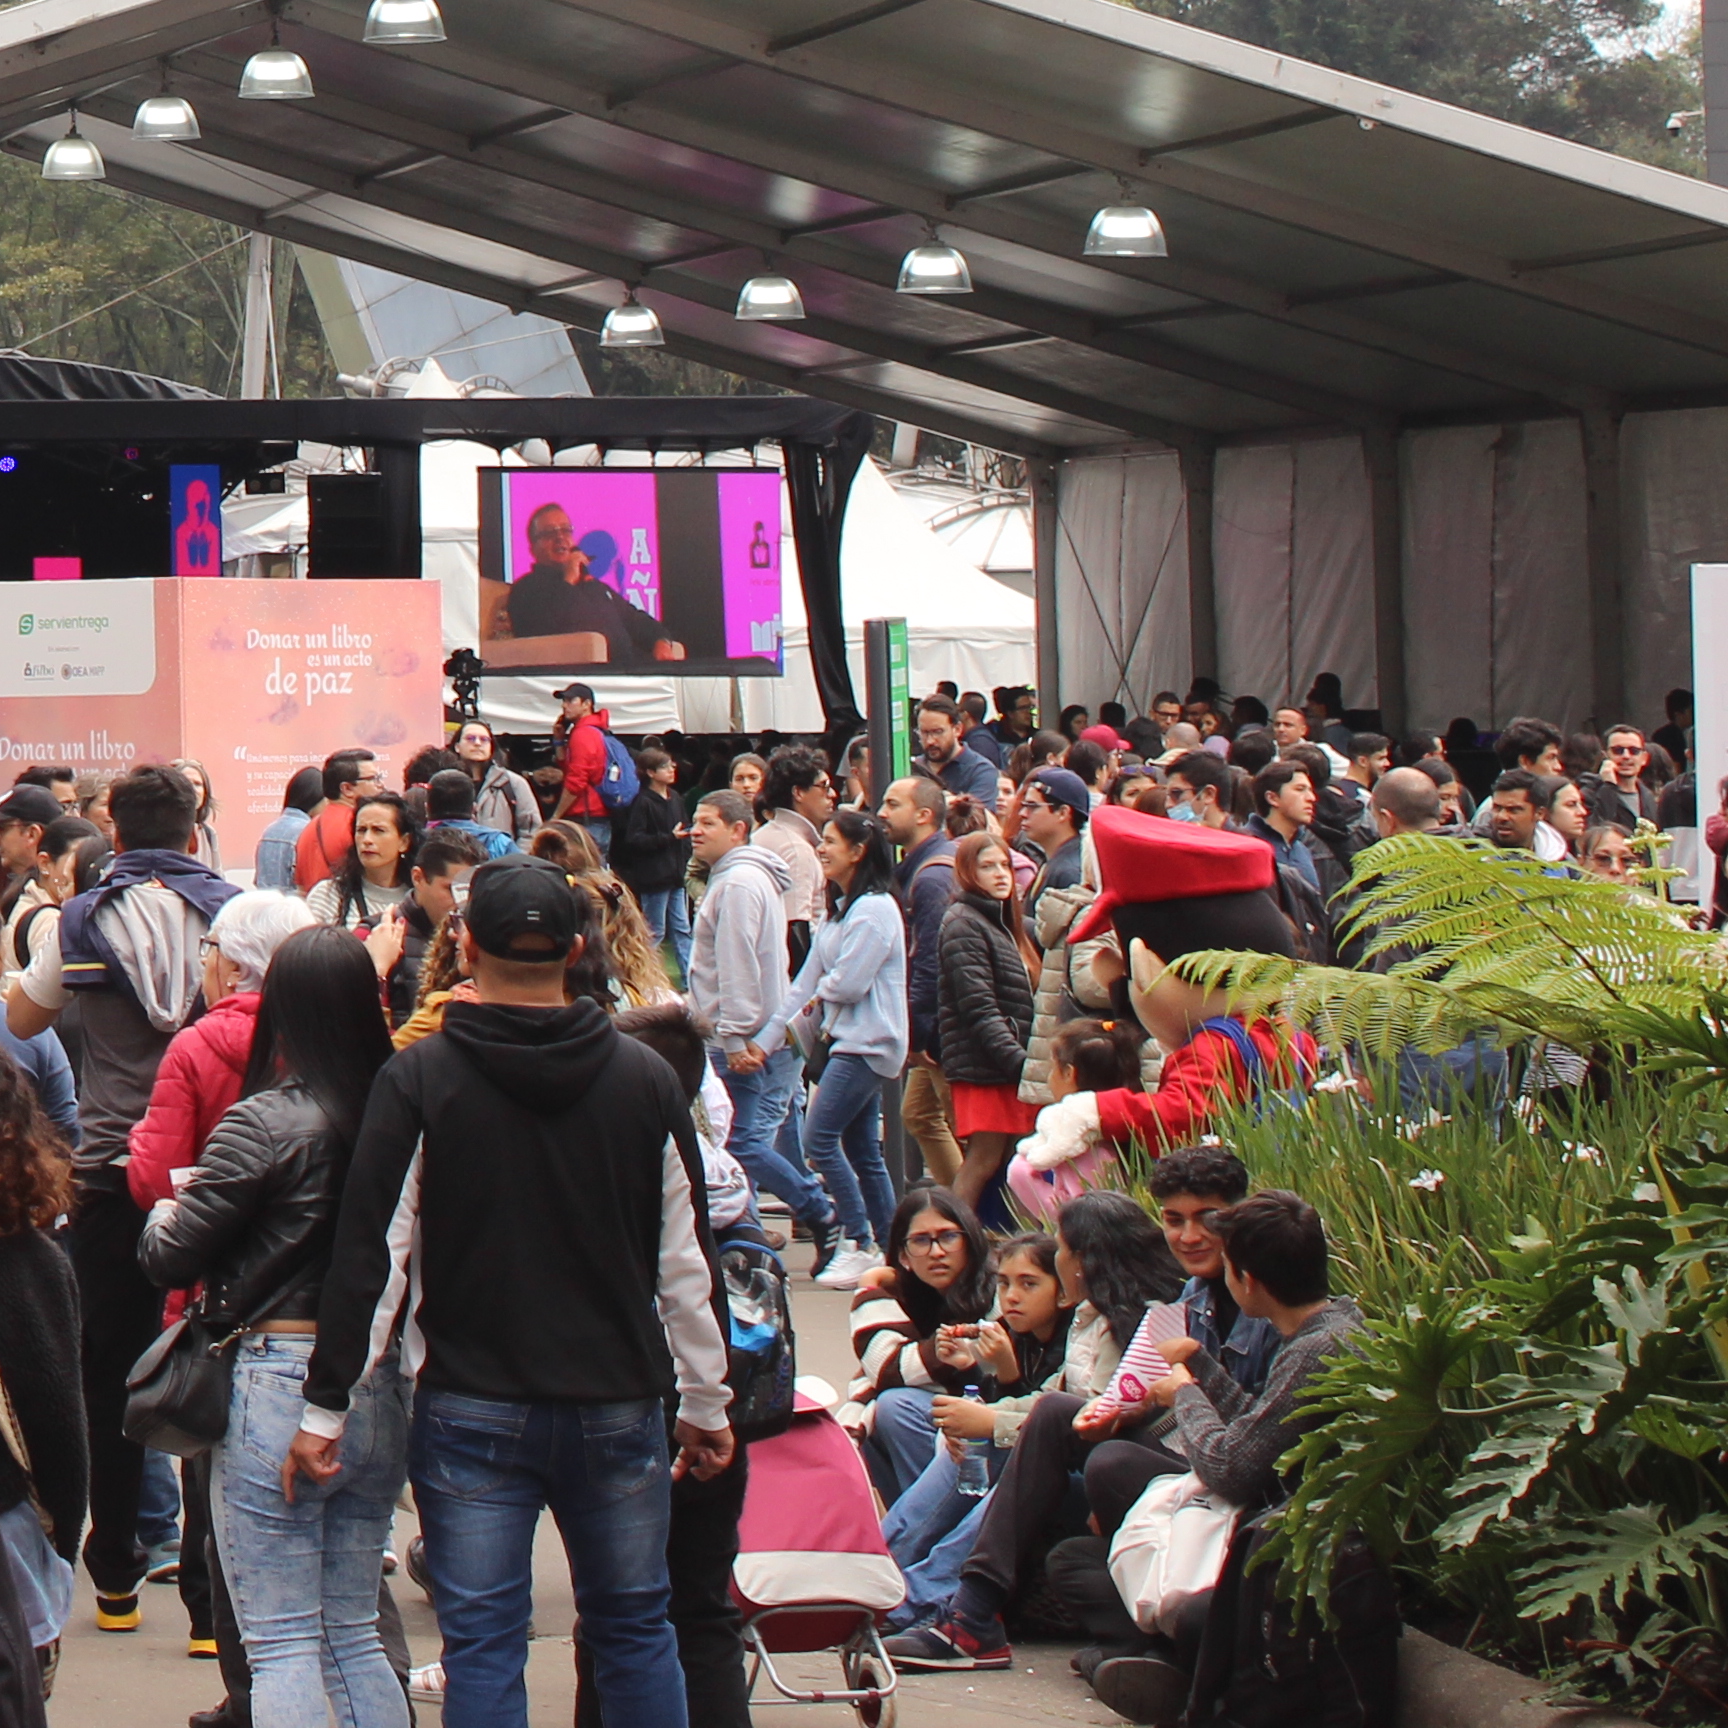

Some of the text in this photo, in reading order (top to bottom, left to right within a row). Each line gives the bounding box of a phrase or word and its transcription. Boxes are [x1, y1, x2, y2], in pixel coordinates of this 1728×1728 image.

[37, 616, 109, 633] servientrega
[246, 624, 372, 649] Donar un libro
[307, 651, 372, 667] es un acto
[265, 657, 353, 706] de paz
[60, 742, 85, 760] un
[90, 729, 136, 760] libro
